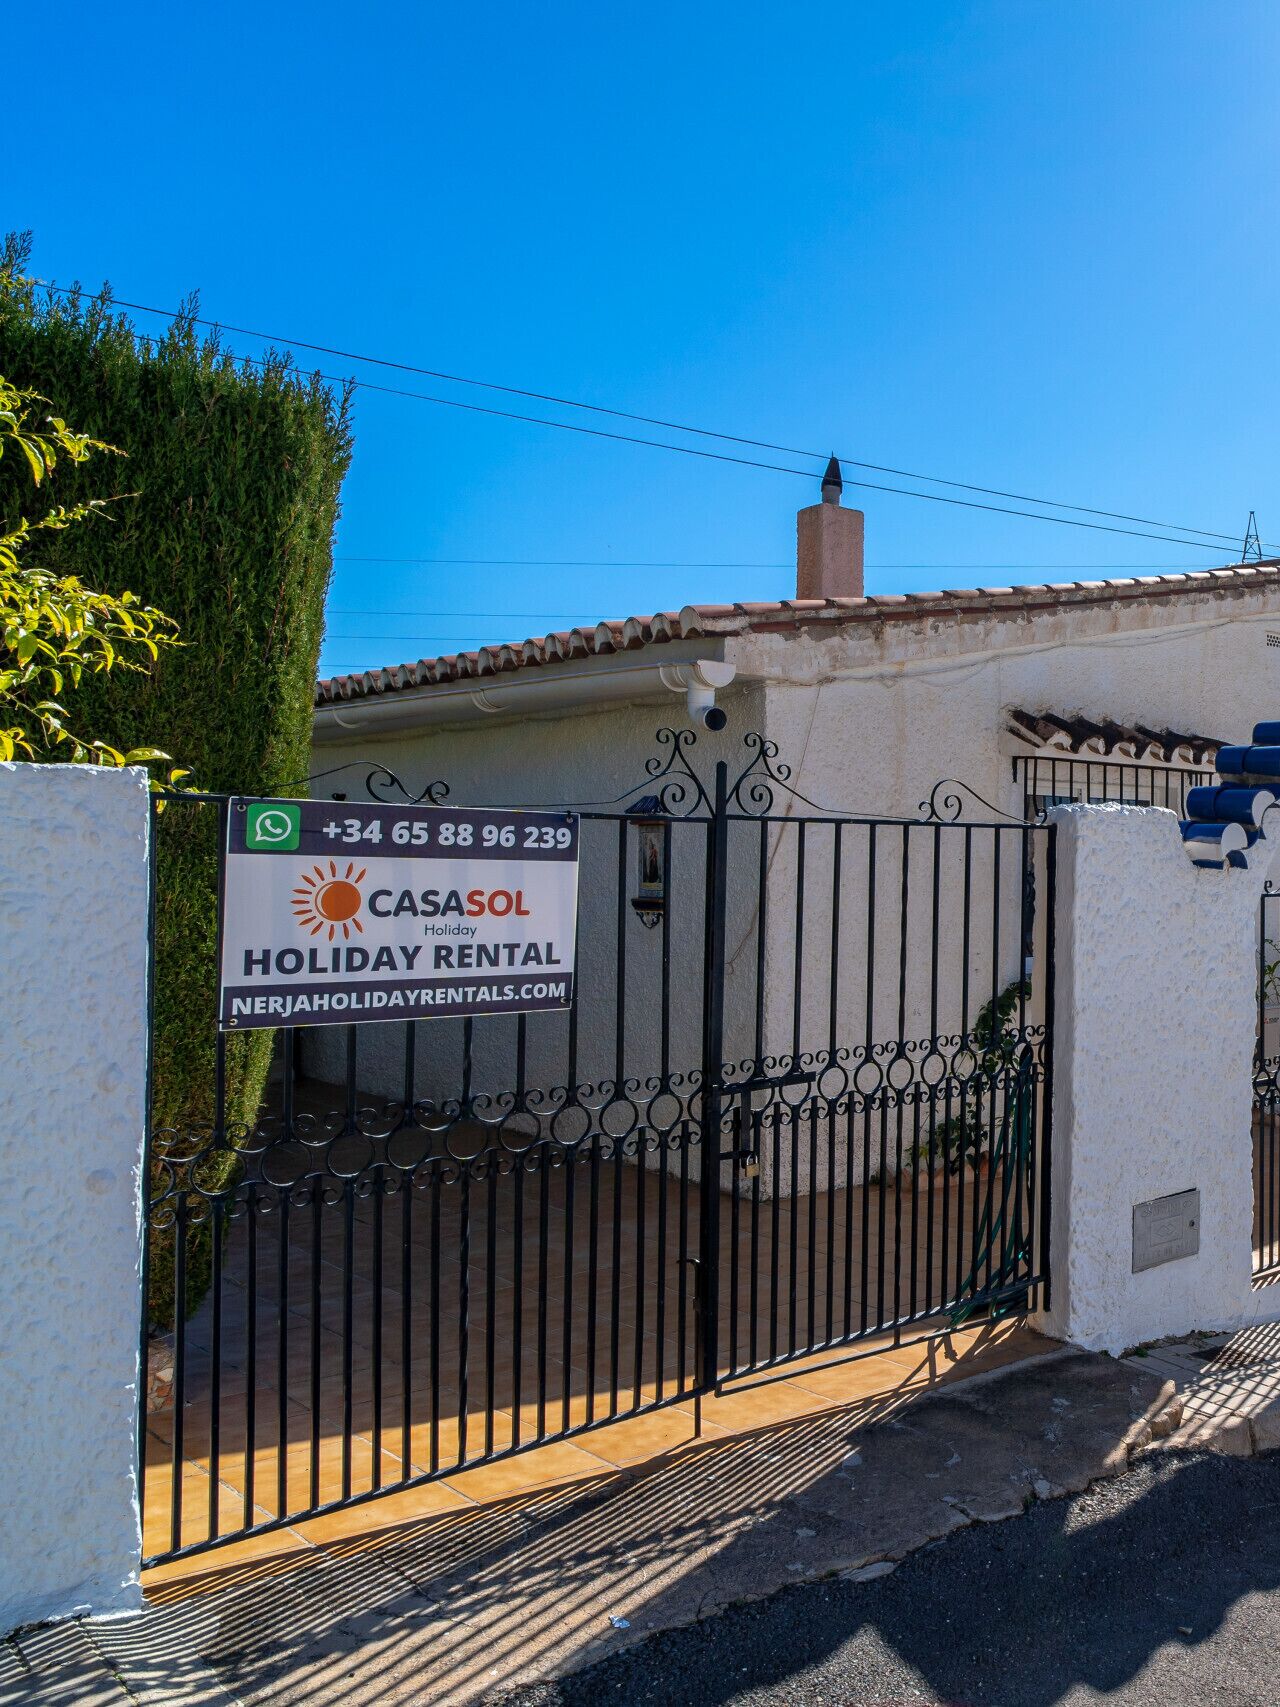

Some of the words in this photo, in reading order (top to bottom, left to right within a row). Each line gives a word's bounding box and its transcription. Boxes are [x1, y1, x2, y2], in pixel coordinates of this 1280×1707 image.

[322, 819, 383, 844] +34
[391, 821, 428, 845] 65
[438, 822, 474, 846] 88
[482, 824, 516, 847] 96
[523, 826, 572, 849] 239
[368, 889, 530, 918] CASASOL
[424, 923, 478, 939] Holiday
[243, 945, 423, 977] HOLIDAY
[433, 942, 561, 970] RENTAL
[232, 982, 566, 1018] NERJAHOLIDAYRENTALS.COM
